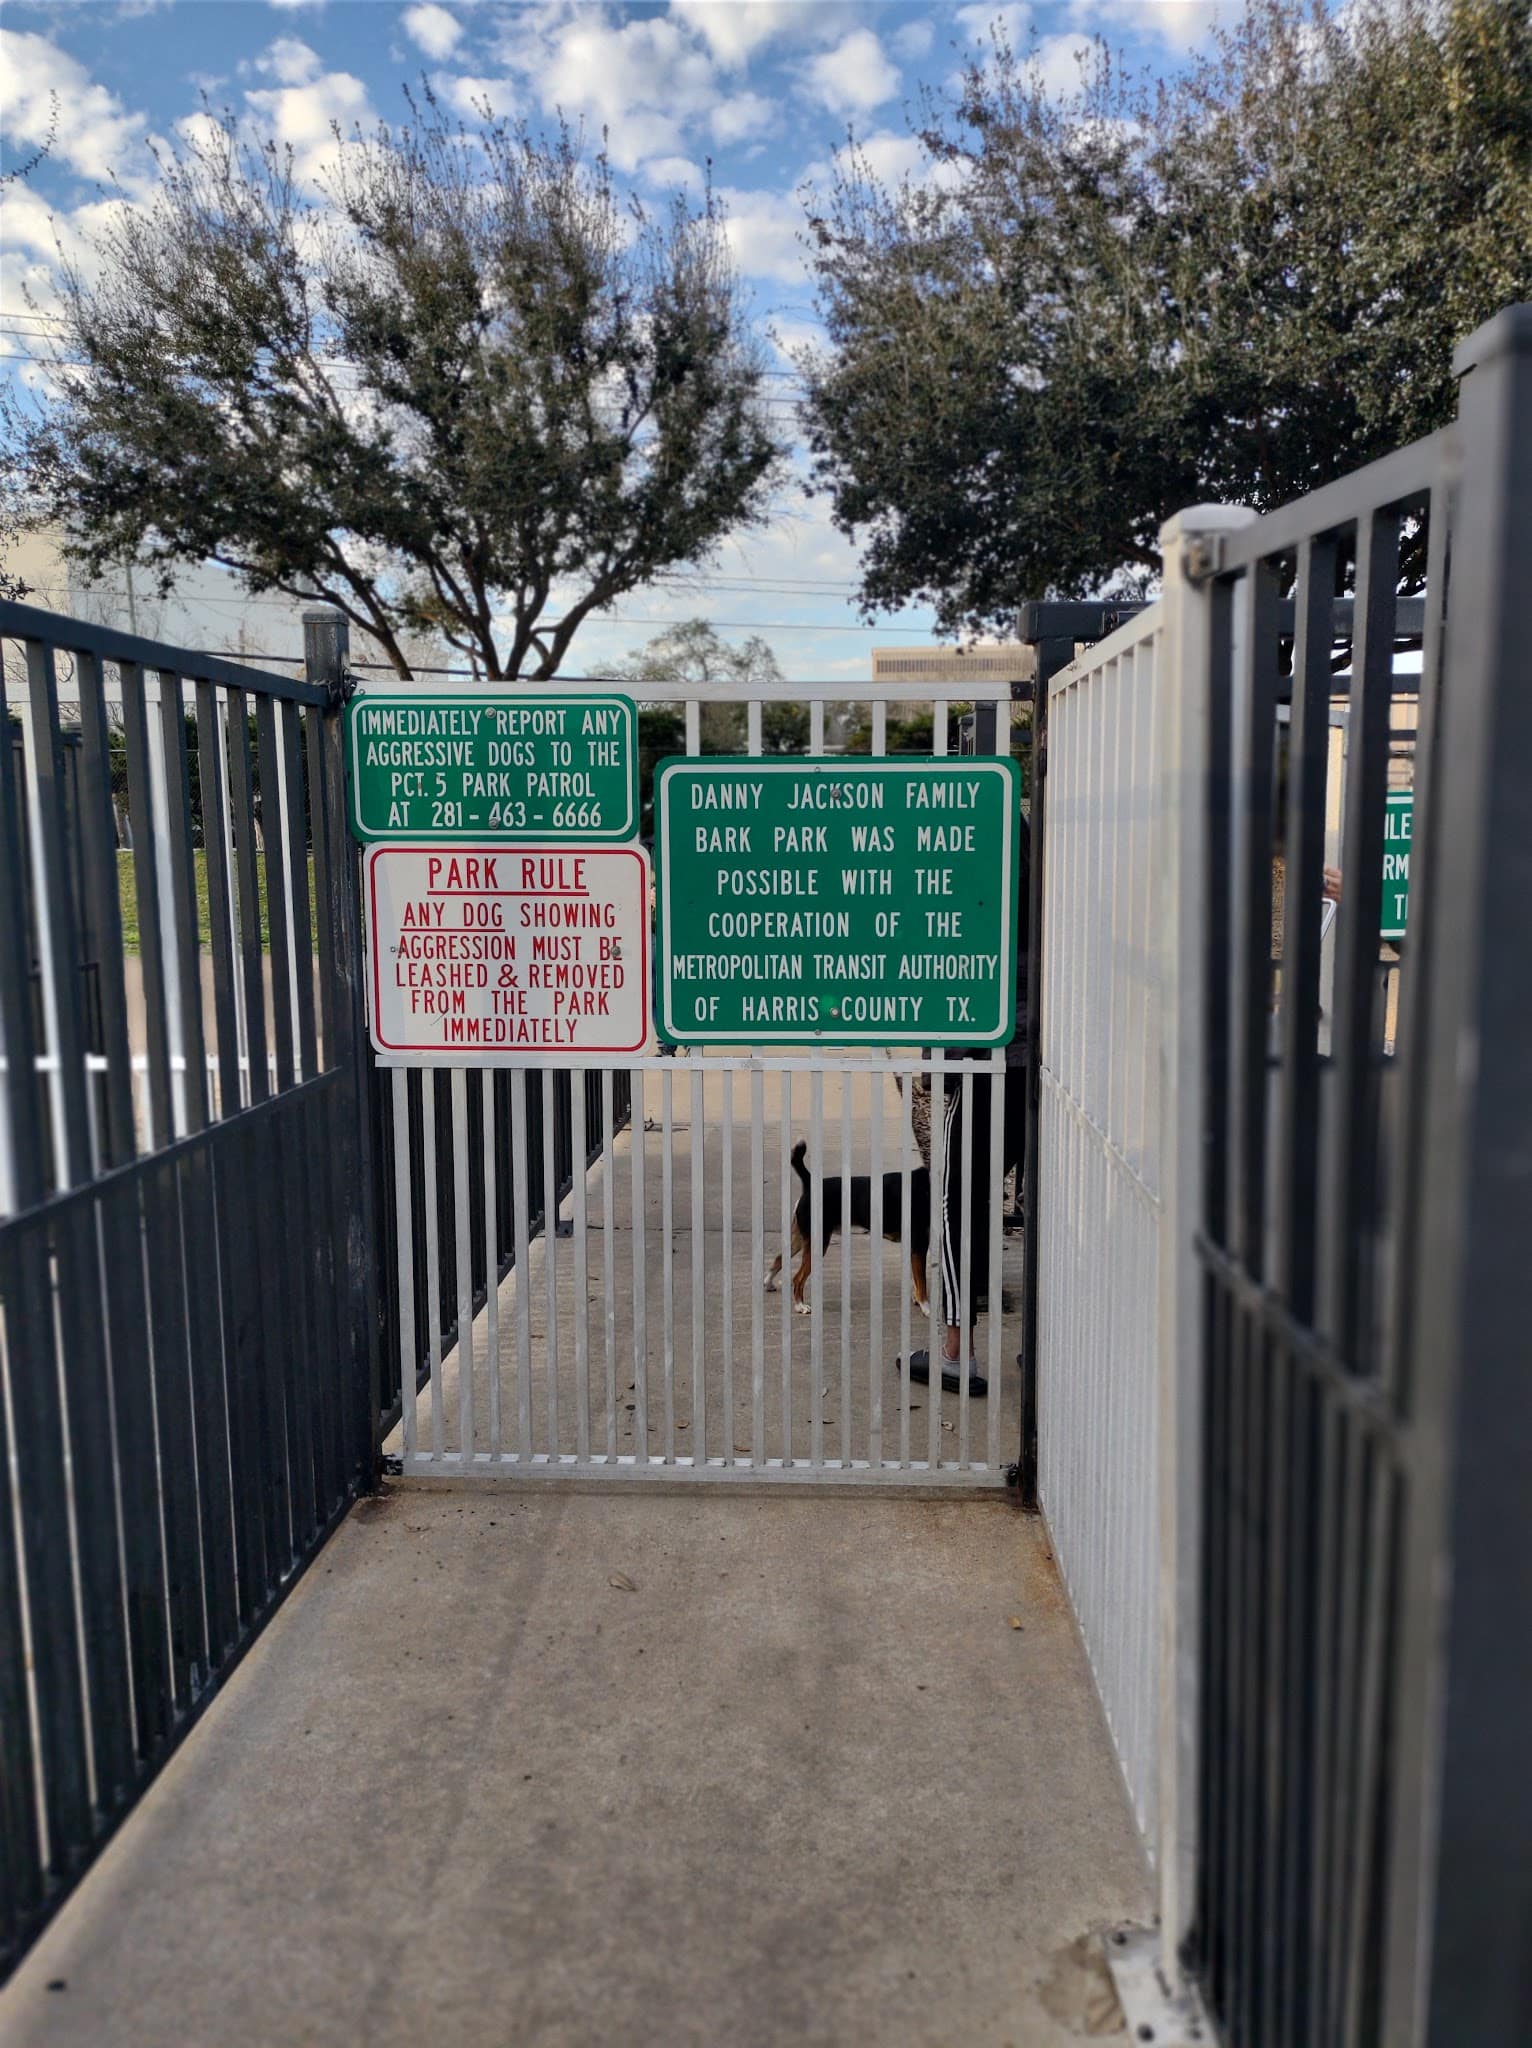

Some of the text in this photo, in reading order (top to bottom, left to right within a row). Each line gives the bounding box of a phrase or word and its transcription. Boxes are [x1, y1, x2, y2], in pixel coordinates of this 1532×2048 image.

[362, 710, 621, 735] IMMEDIATELY REPORT ANY
[366, 742, 620, 766] AGGRESSIVE DOGS TO THE
[391, 772, 596, 798] PCT. 5 PARK PATROL
[691, 782, 980, 809] DANNY JACKSON FAMILY
[388, 802, 410, 827] AT
[696, 826, 976, 852] BARK PARK WAS MADE
[428, 858, 586, 890] PARK RULE
[718, 869, 953, 895] POSSIBLE WITH THE
[404, 902, 616, 928] ANY DOG SHOWING
[708, 912, 962, 938] COOPERATION OF THE
[398, 936, 622, 960] AGGRESSION MUST BE
[396, 964, 624, 988] LEASHED & REMOVED
[673, 955, 998, 980] METROPOLITAN TRANSIT AUTHORITY
[412, 990, 610, 1016] FROM THE PARK
[694, 997, 976, 1021] OF HARRIS COUNTY TX.
[444, 1018, 578, 1042] IMMEDIATELY
